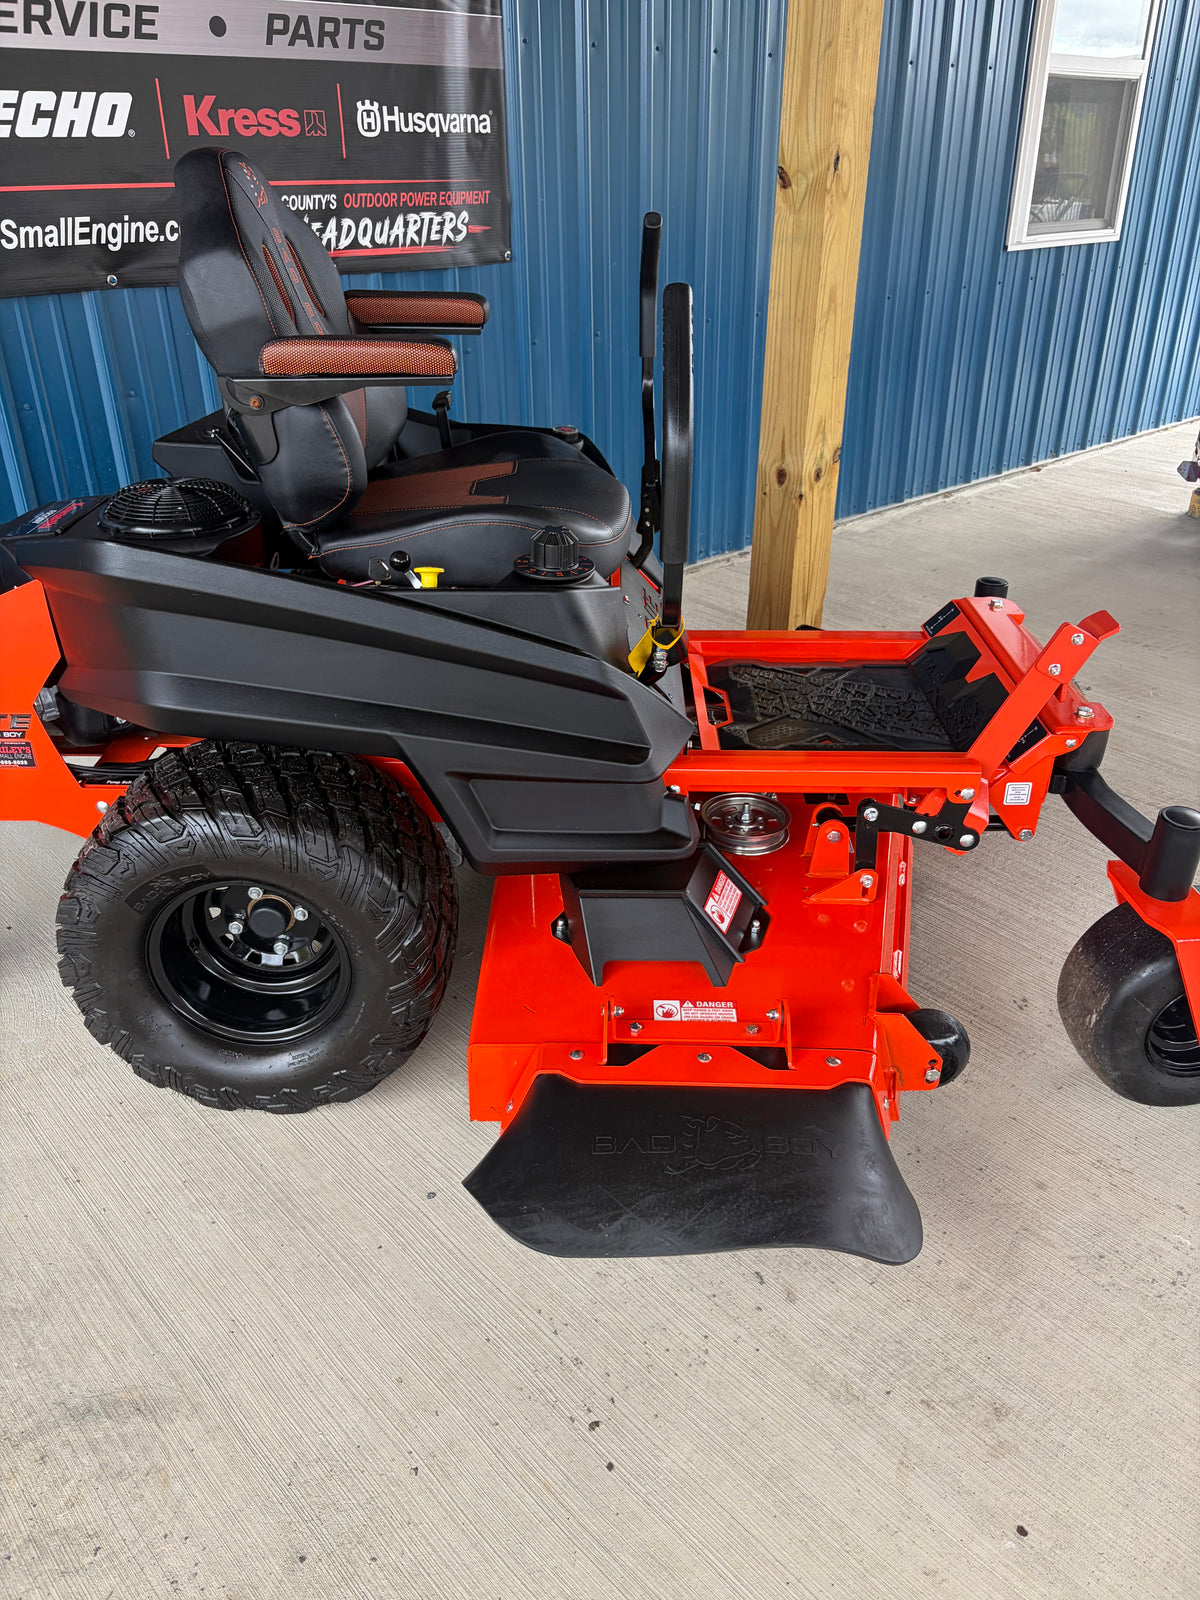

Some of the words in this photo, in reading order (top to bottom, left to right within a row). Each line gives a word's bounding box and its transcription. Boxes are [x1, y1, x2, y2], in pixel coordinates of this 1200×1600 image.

[265, 13, 385, 51] PARTS
[0, 90, 134, 138] ECHO
[183, 94, 301, 138] Kress
[383, 105, 492, 138] Husqvarna
[343, 192, 398, 208] OUTDOOR
[400, 191, 437, 207] POWER
[439, 190, 490, 206] EQUIPMENT
[0, 214, 181, 252] SmallEngine.c
[303, 210, 469, 253] EADQUARTERS
[591, 1136, 677, 1155] BAD
[766, 1136, 836, 1159] BOY
